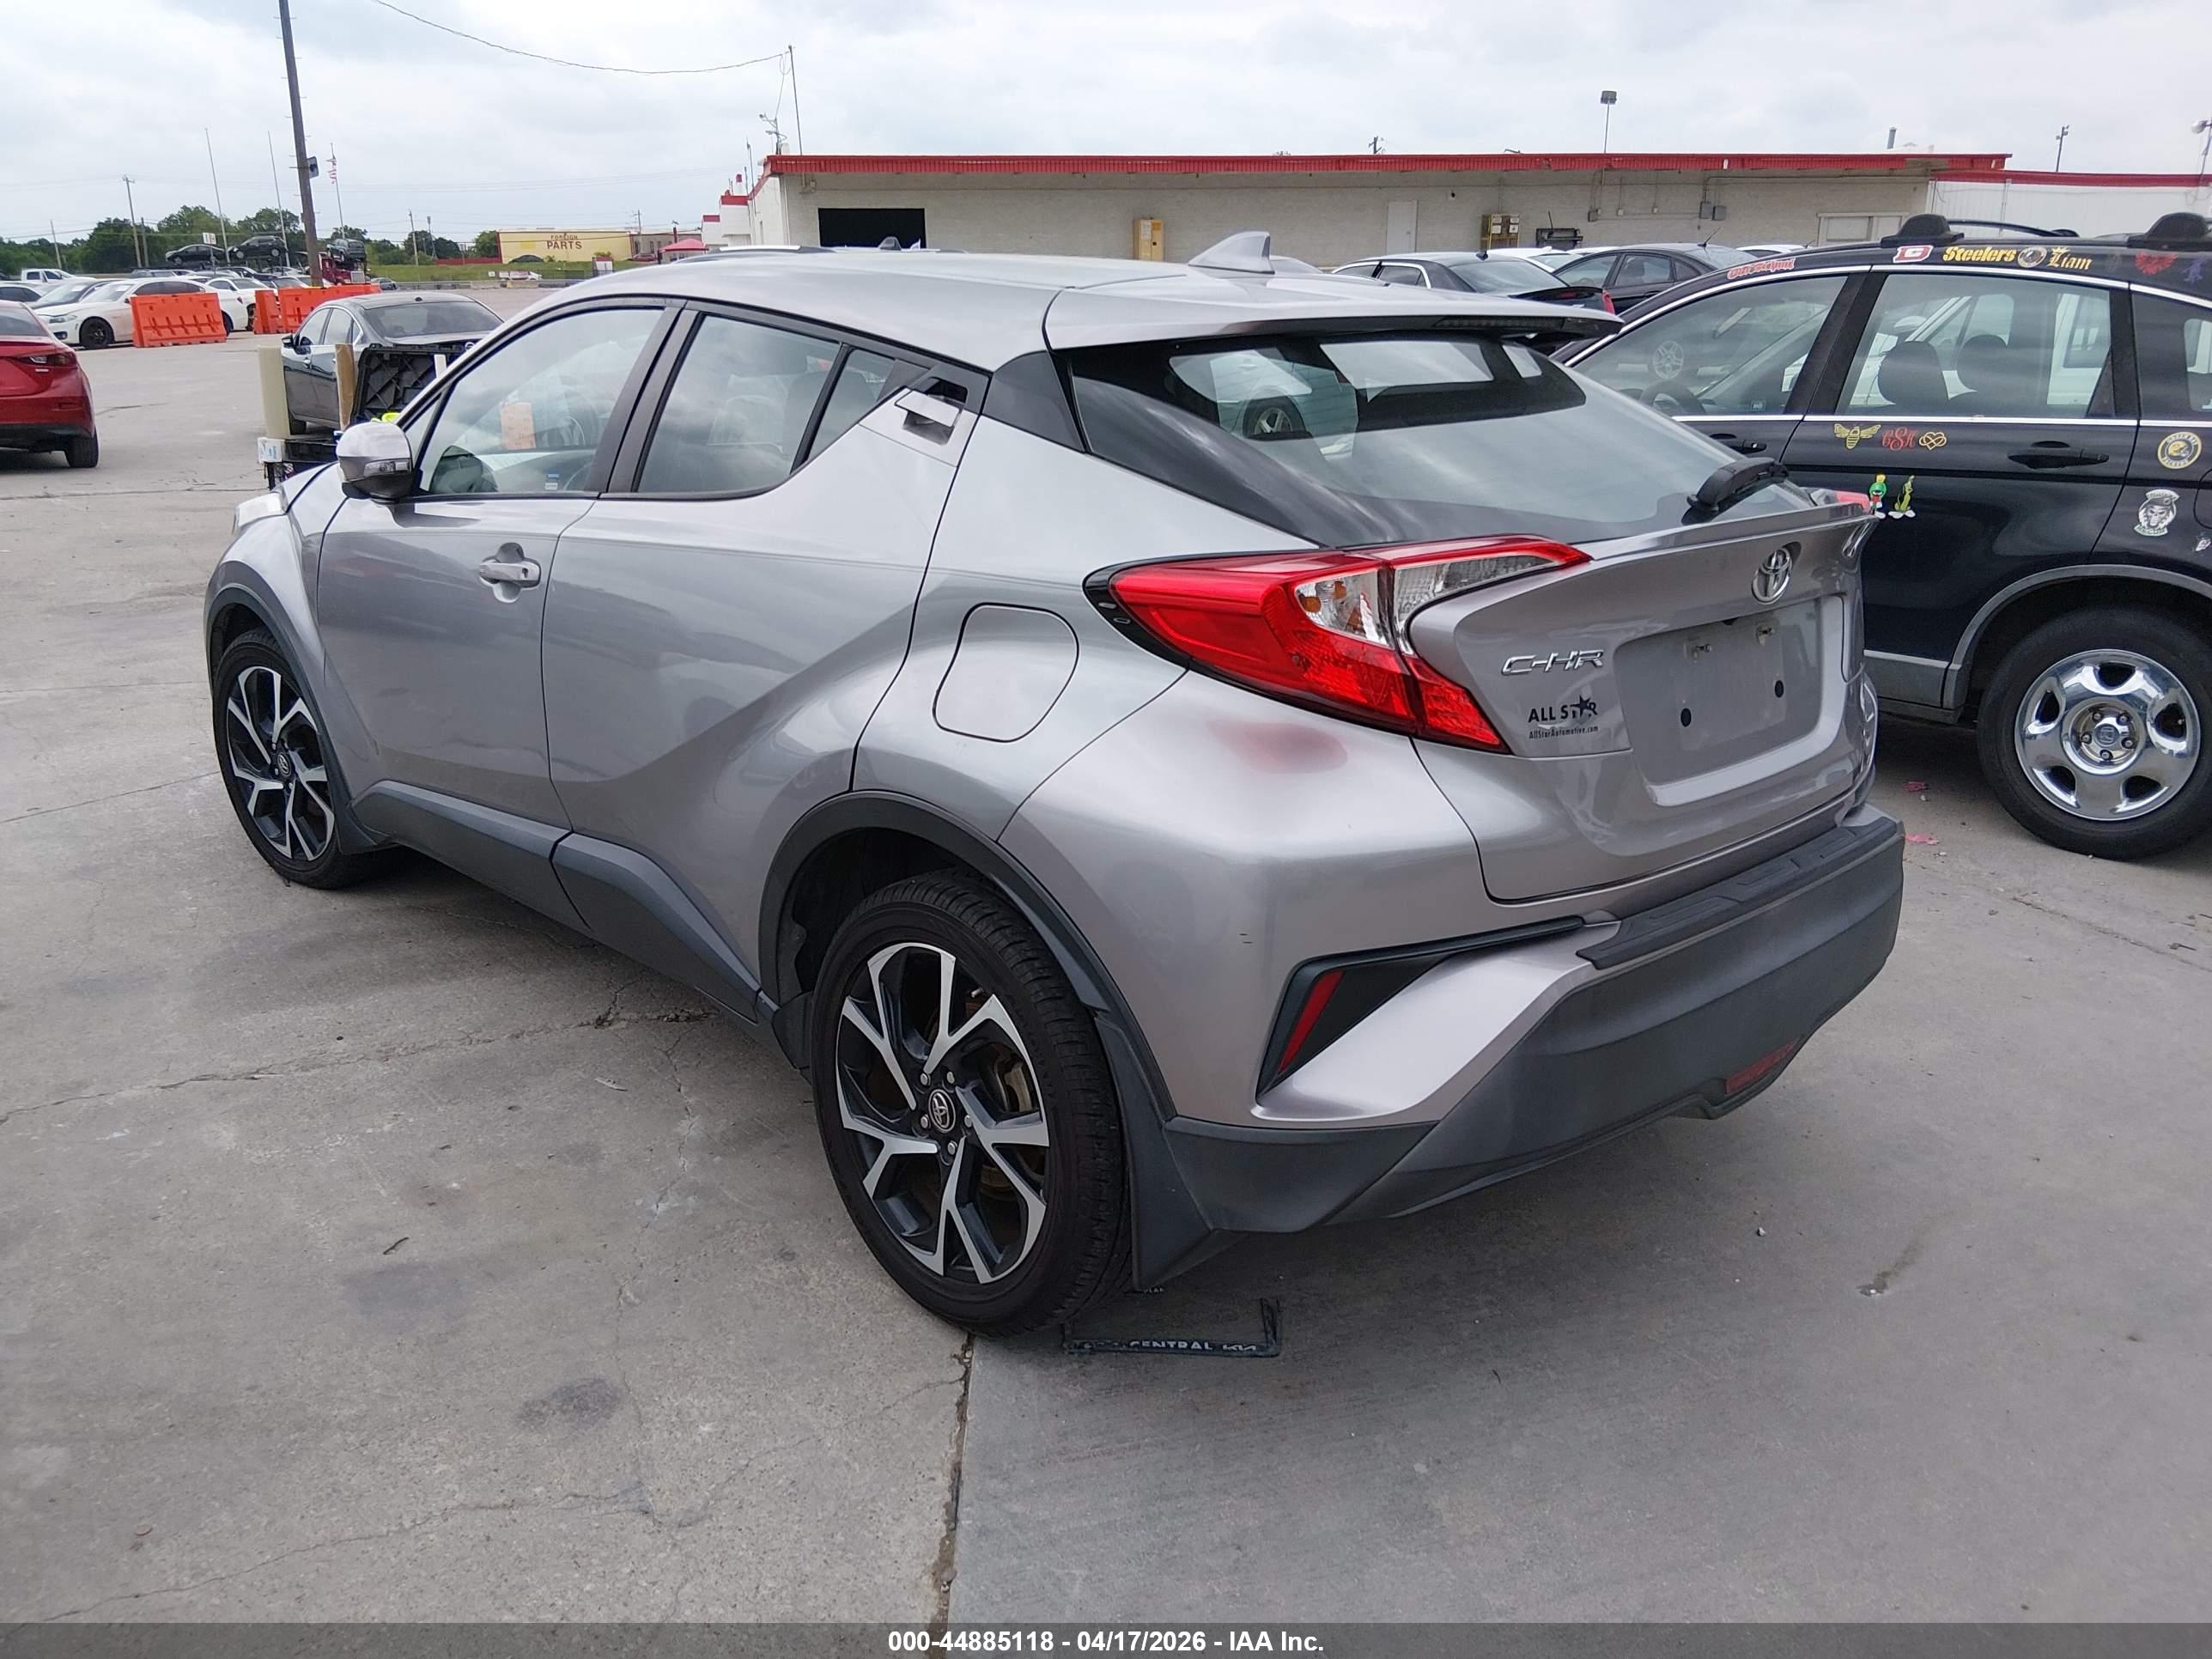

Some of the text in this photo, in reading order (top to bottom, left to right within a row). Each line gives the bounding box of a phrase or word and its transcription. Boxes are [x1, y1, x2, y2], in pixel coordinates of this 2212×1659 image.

[546, 240, 583, 250] PARTS
[1942, 246, 2017, 262] Steelers
[2047, 247, 2094, 270] Liam
[1502, 649, 1604, 675] C-HR
[1528, 706, 1556, 723] ALL
[1528, 726, 1598, 739] AllStarAutomotive.com
[1129, 1340, 1213, 1351] CENTRAL
